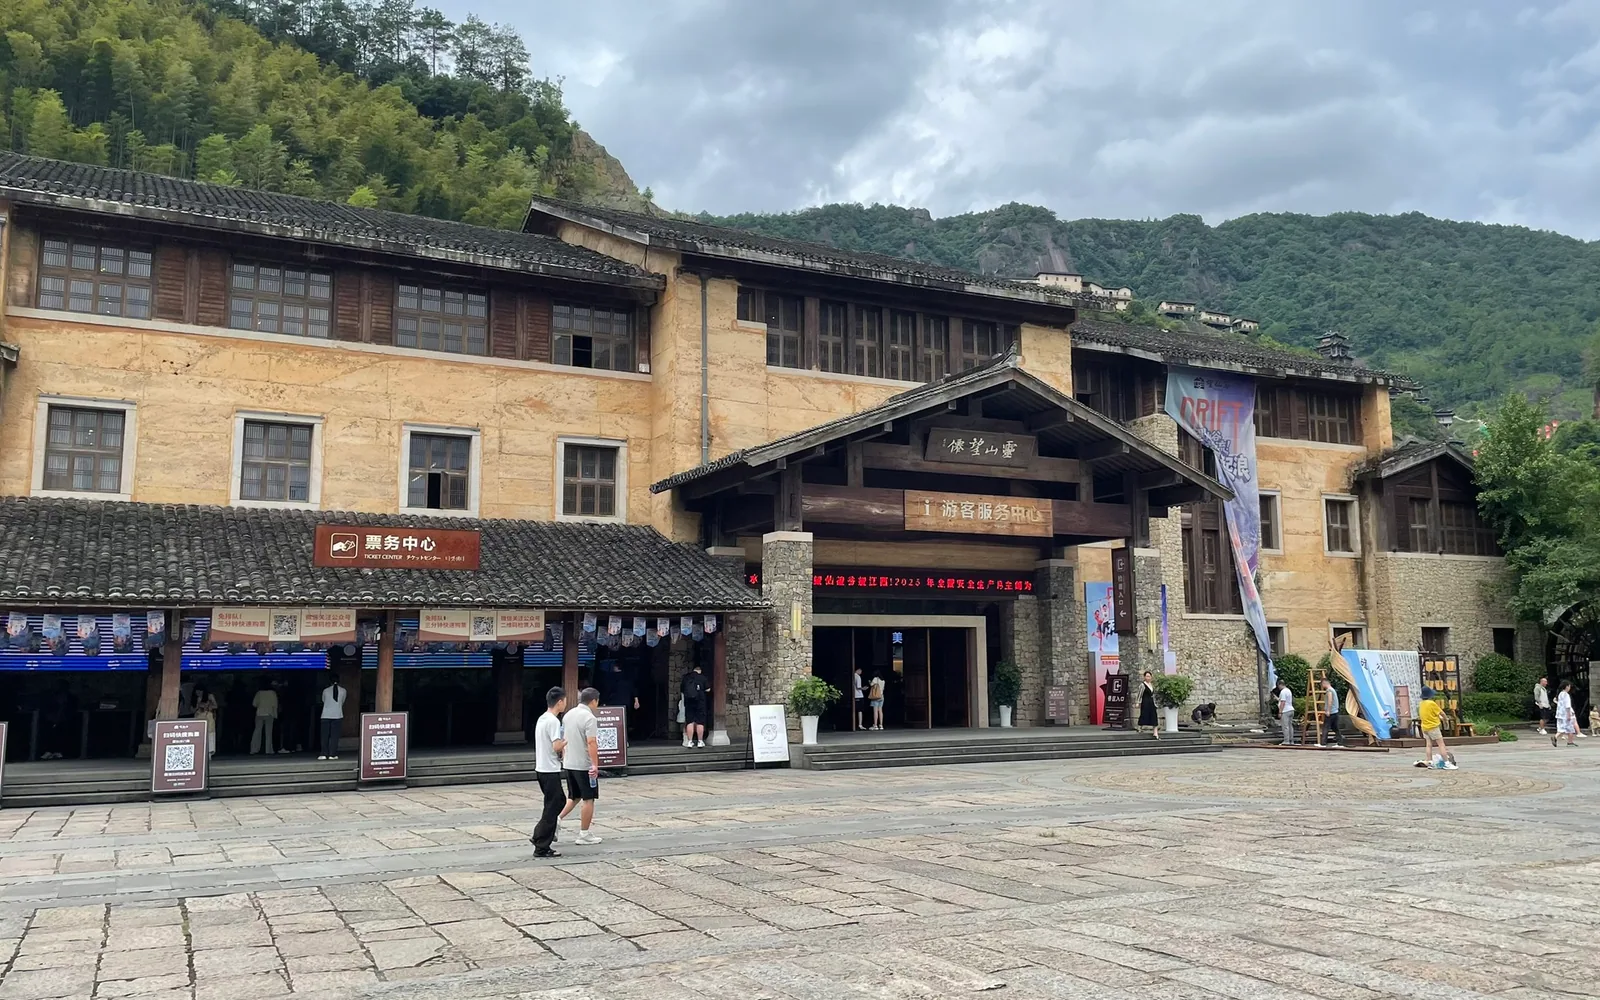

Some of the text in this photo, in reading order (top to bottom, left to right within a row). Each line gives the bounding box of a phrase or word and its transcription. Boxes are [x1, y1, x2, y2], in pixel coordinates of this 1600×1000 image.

[1180, 396, 1243, 454] DRIFT
[941, 499, 1041, 522] 游客服务中心
[364, 534, 436, 552] 票务中心
